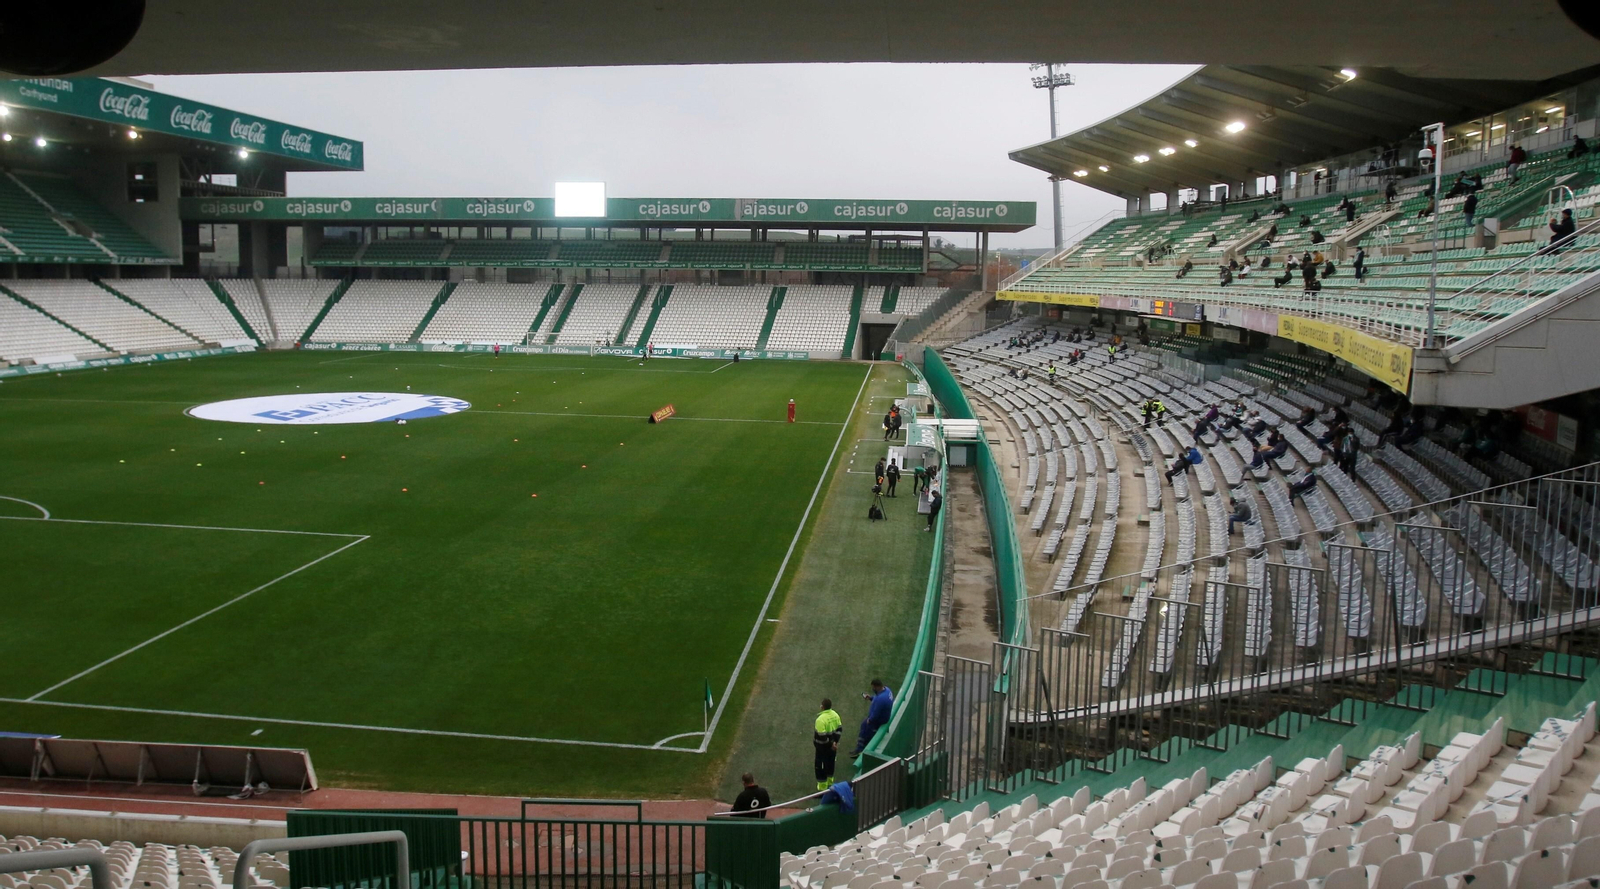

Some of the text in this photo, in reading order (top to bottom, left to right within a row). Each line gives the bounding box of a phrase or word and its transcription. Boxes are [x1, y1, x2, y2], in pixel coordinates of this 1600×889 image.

[24, 78, 73, 92] UNDAI
[286, 200, 339, 216] cajasur
[375, 200, 430, 216] cajasur
[466, 200, 522, 216] cajasur
[638, 201, 697, 217] cajasur
[834, 202, 894, 218] cajasur
[933, 203, 993, 219] cajasur
